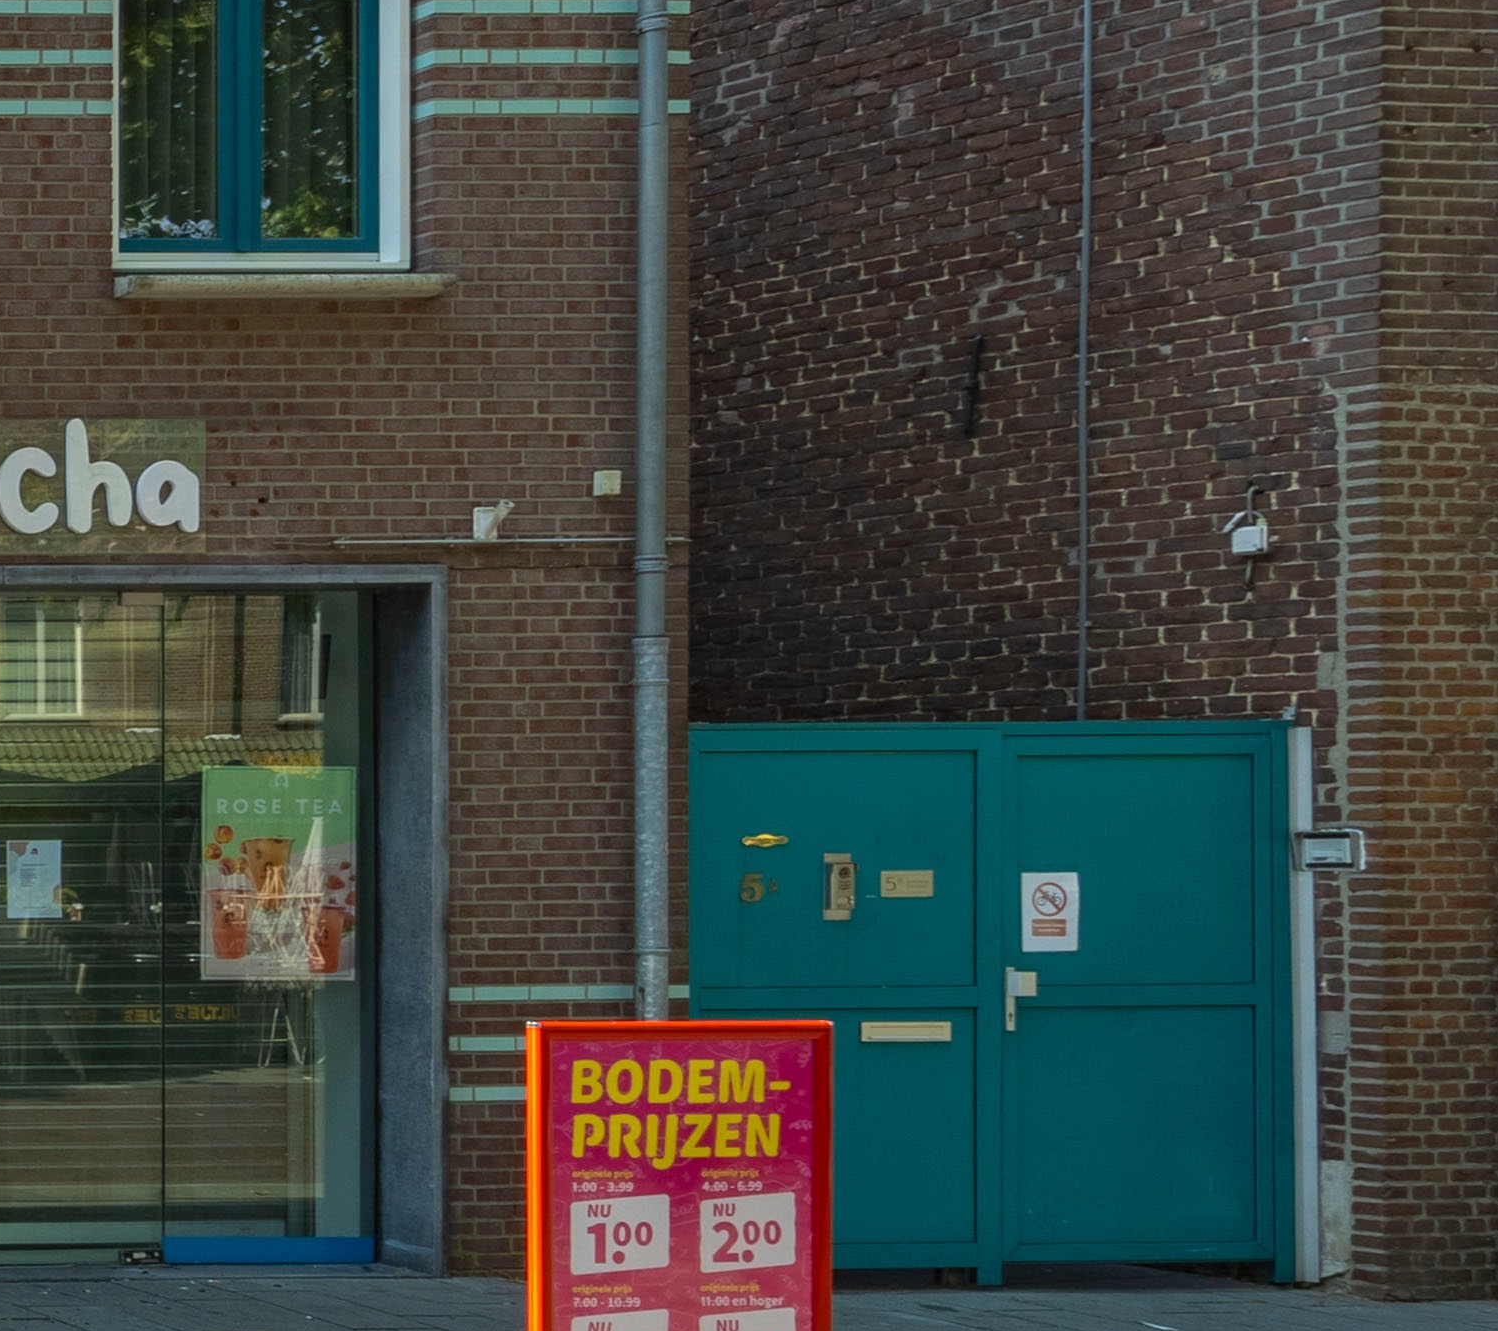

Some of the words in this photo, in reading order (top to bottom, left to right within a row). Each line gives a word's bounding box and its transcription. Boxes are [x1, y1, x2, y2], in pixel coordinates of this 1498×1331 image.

[216, 798, 282, 815] ROSE
[295, 798, 343, 815] TEA
[569, 1059, 791, 1104] BODEM-
[571, 1113, 781, 1170] PRIJZEN
[572, 1170, 612, 1180] originele
[613, 1170, 634, 1180] prijs
[701, 1169, 738, 1179] originele
[740, 1169, 760, 1179] prijs
[572, 1182, 598, 1192] 1.00
[607, 1182, 634, 1192] 3.99
[702, 1181, 728, 1192] 4.00
[737, 1181, 763, 1192] 6.99
[587, 1203, 612, 1218] NU
[713, 1203, 736, 1217] NU
[586, 1221, 653, 1265] 1.00
[712, 1220, 782, 1264] 2.00
[572, 1285, 612, 1295] originele
[613, 1284, 633, 1295] prijs
[700, 1283, 738, 1294] originele
[740, 1283, 759, 1294] prijs
[572, 1297, 598, 1308] 7.00
[607, 1297, 641, 1308] 10.99
[701, 1296, 729, 1307] 11.00
[731, 1297, 747, 1307] en
[749, 1295, 784, 1309] hoger
